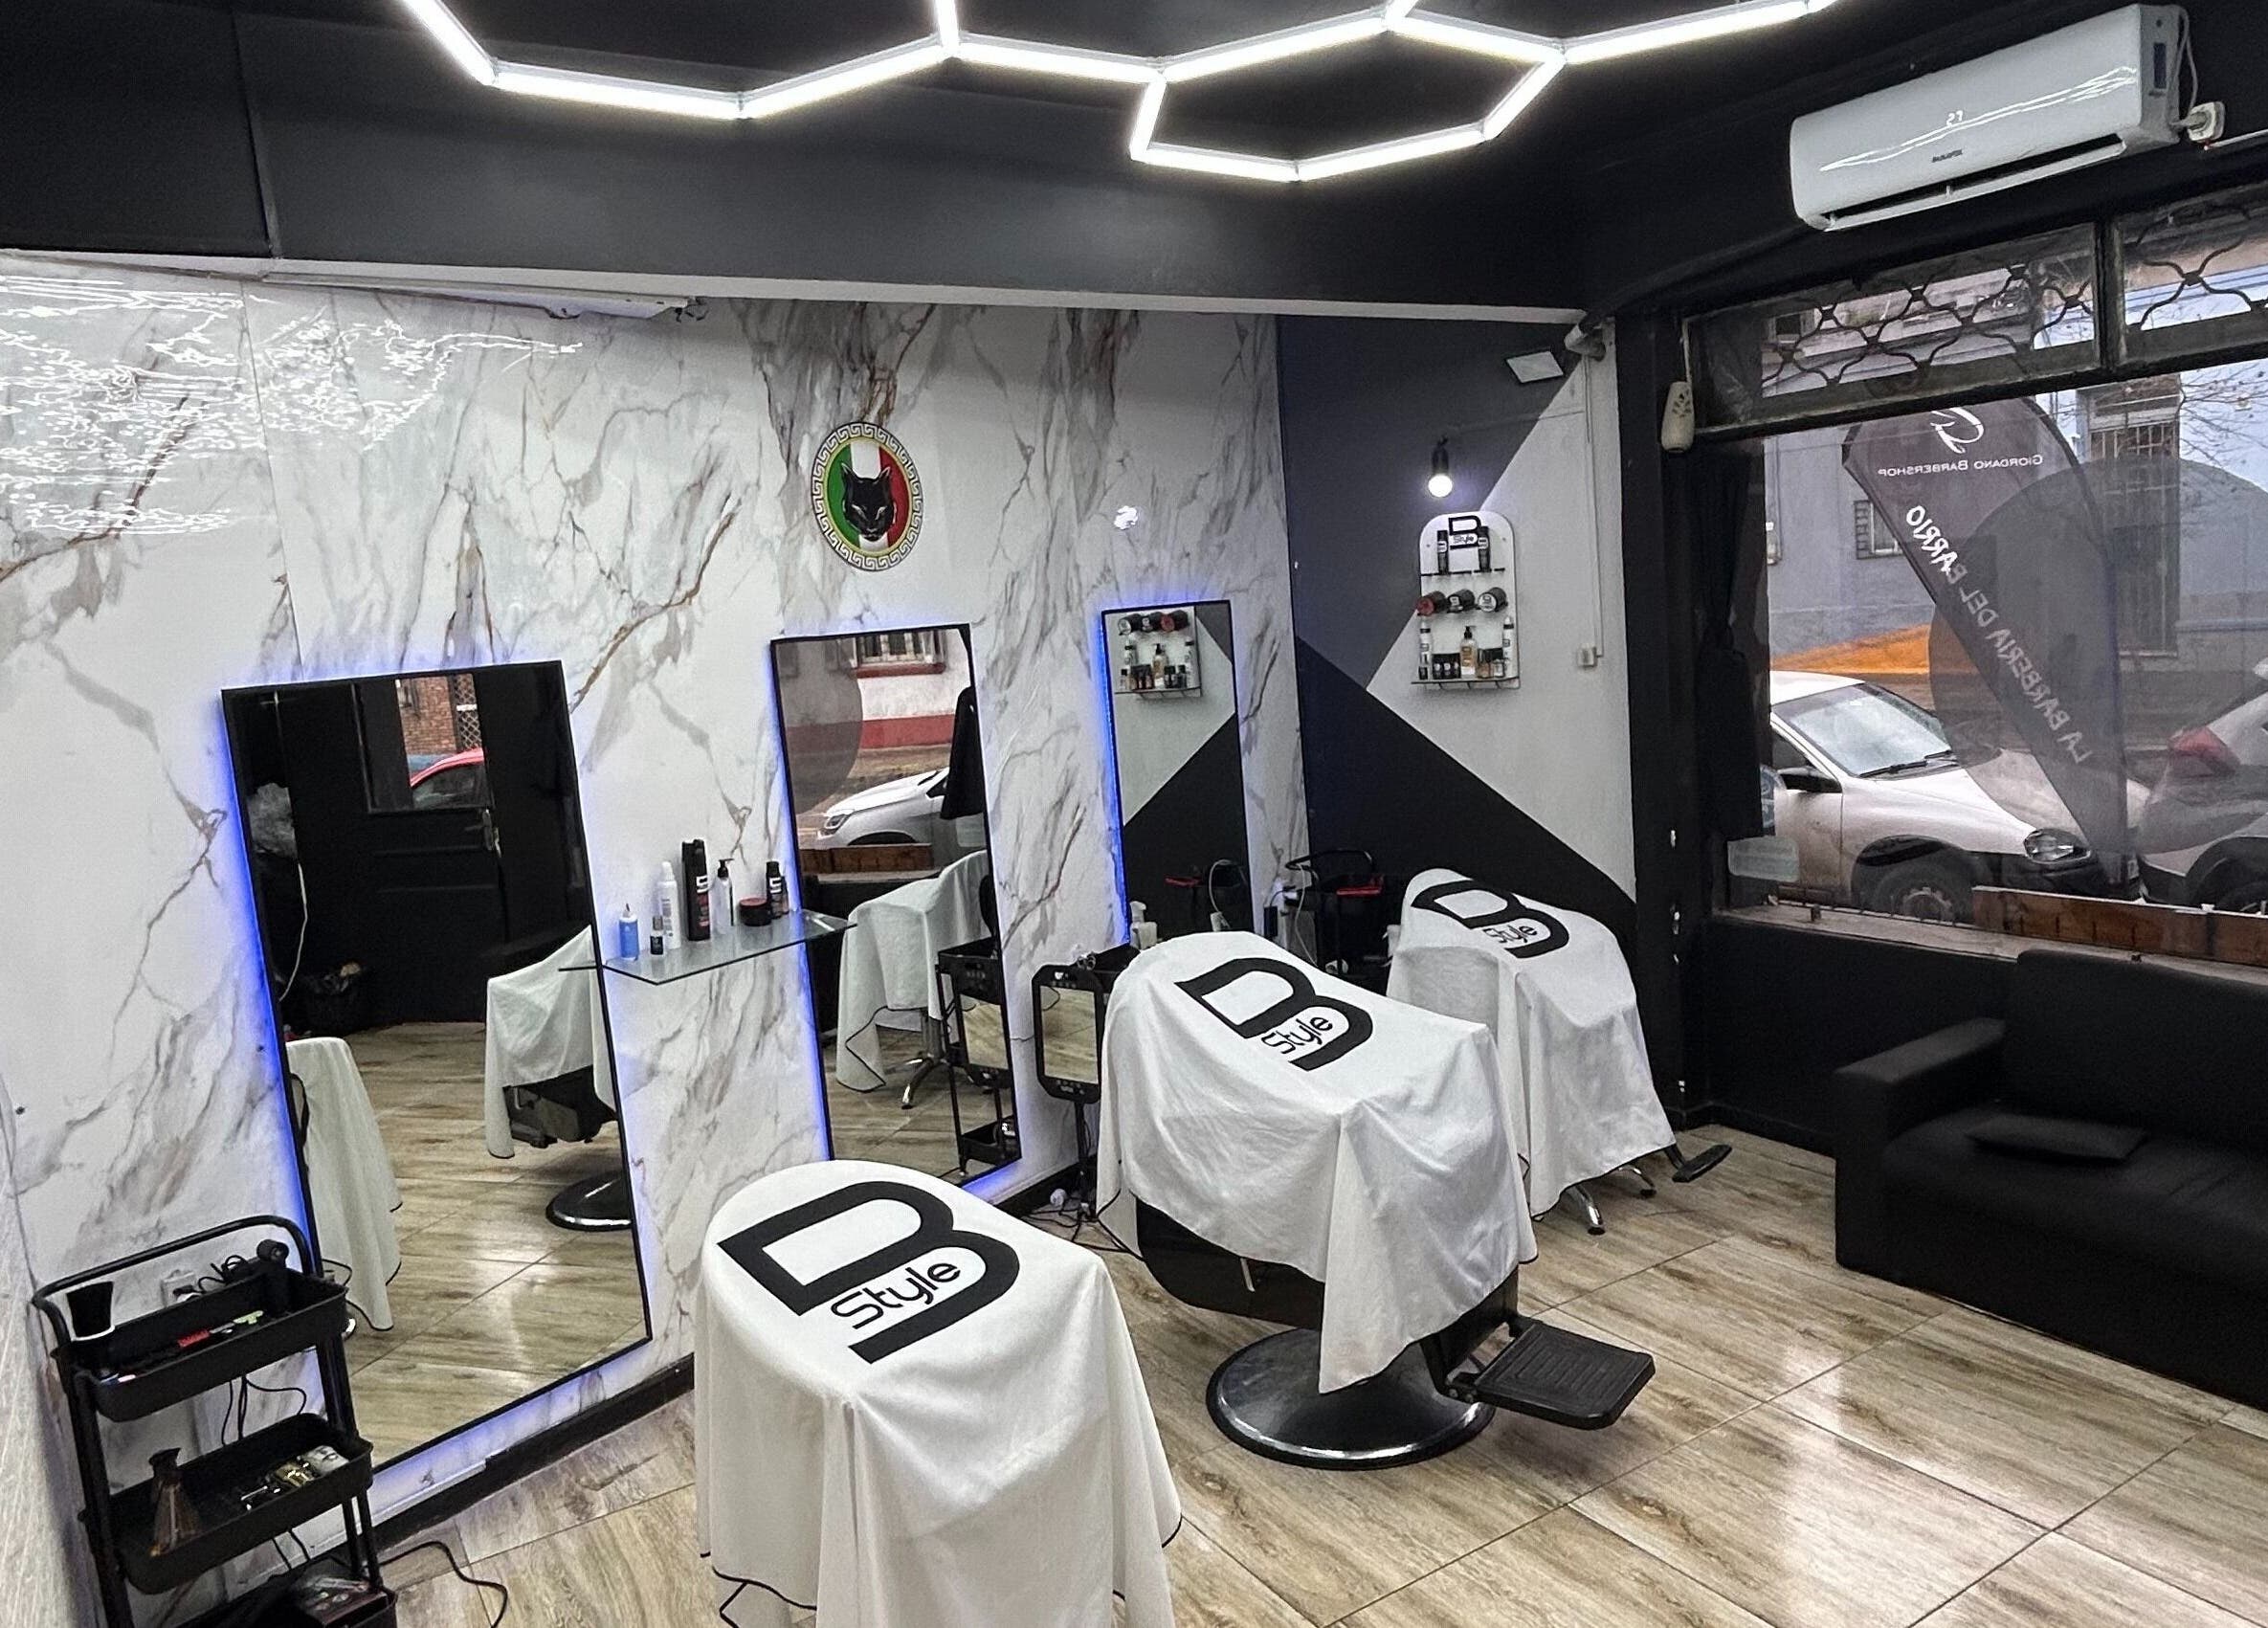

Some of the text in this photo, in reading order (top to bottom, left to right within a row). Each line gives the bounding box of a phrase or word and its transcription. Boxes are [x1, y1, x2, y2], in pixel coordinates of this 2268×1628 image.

[1481, 924, 1538, 944] Style
[1260, 1016, 1333, 1055] Style
[830, 1262, 962, 1329] Style
